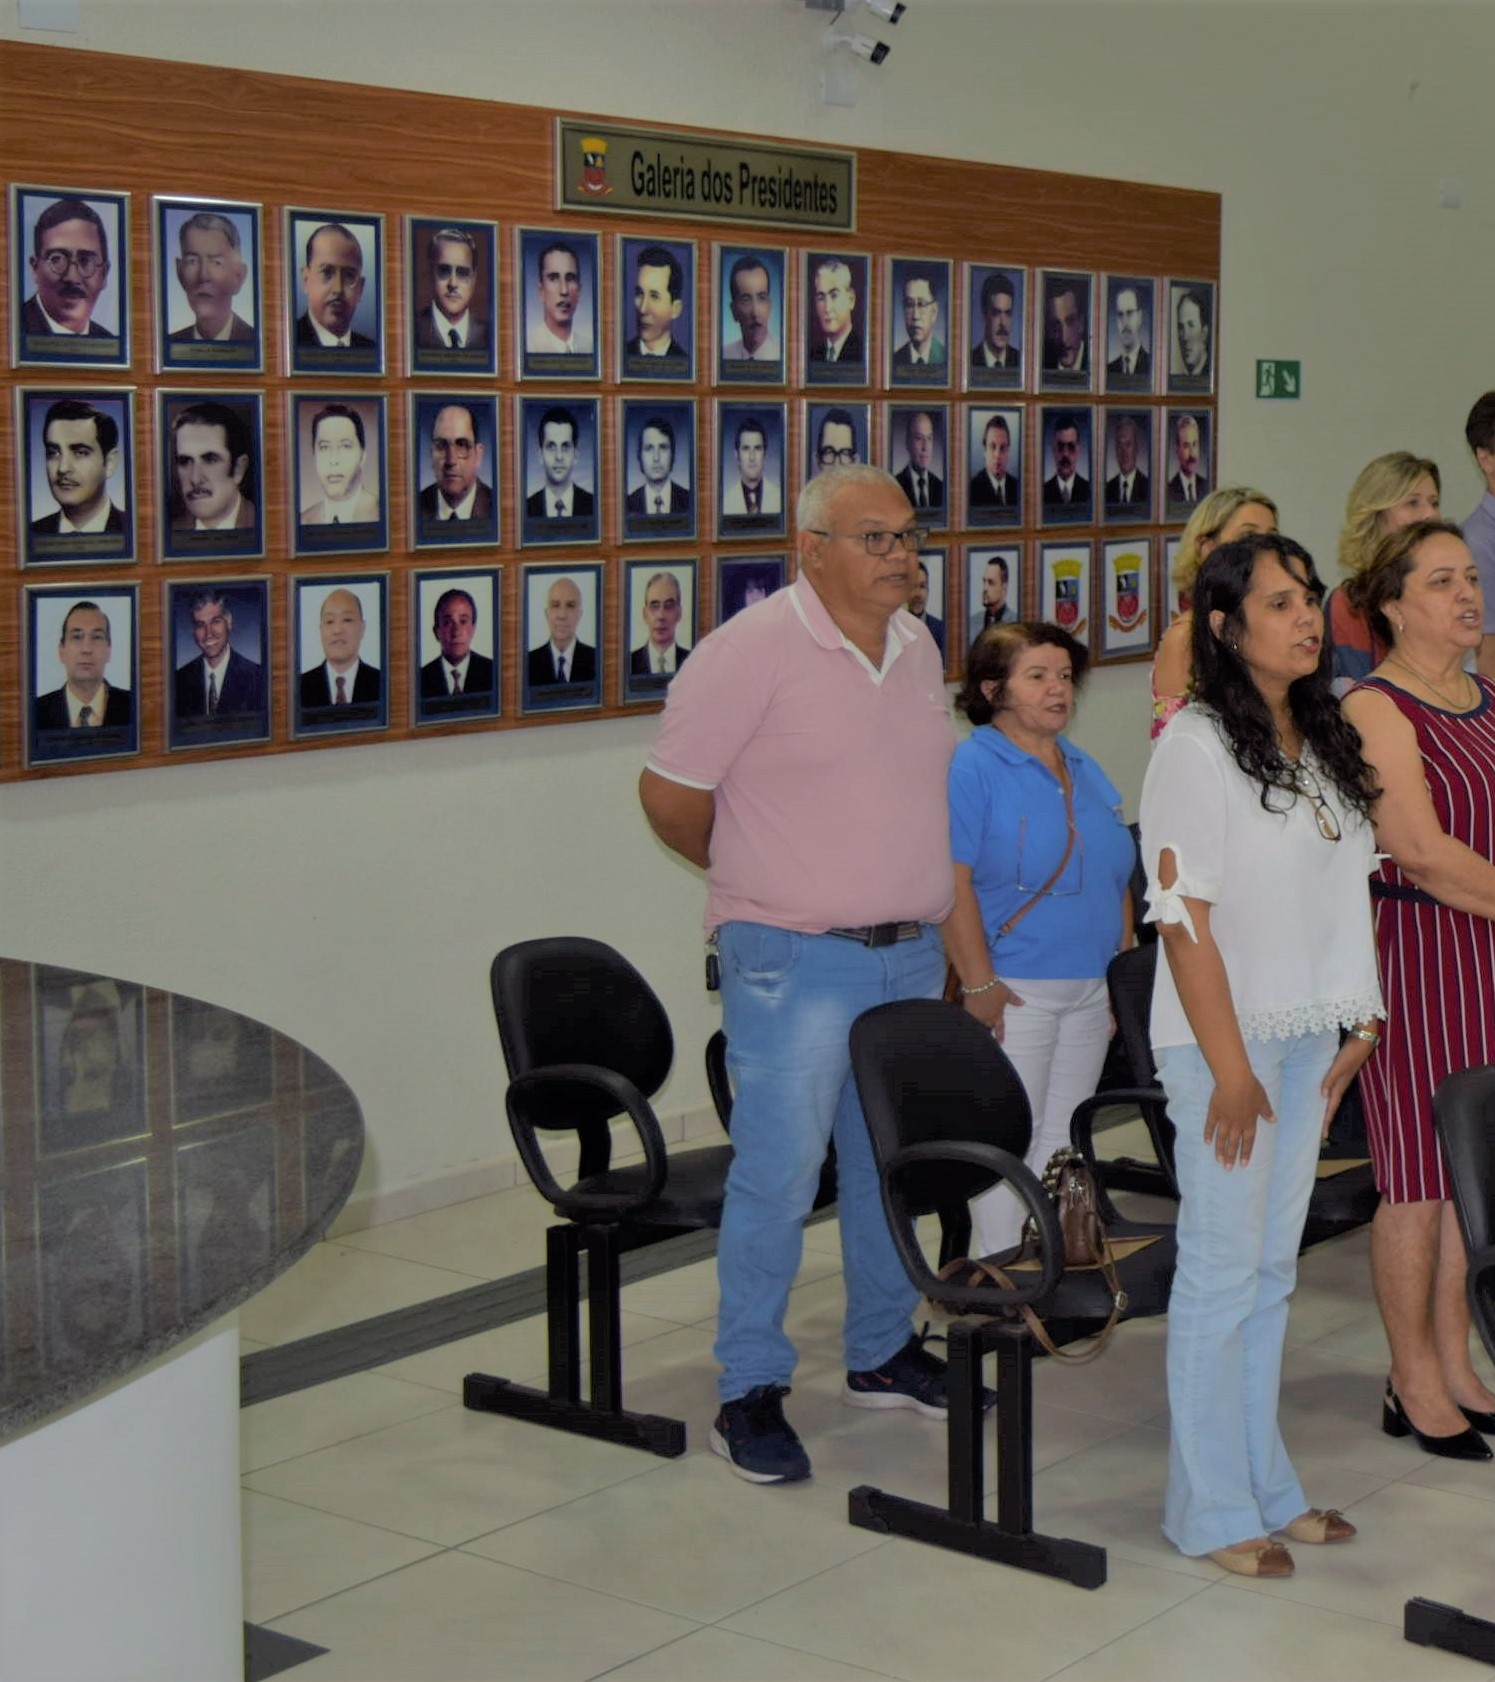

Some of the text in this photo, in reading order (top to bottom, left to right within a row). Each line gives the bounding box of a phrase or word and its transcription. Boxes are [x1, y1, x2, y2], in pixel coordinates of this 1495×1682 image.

[631, 150, 838, 215] Galeria dos Presidentes
